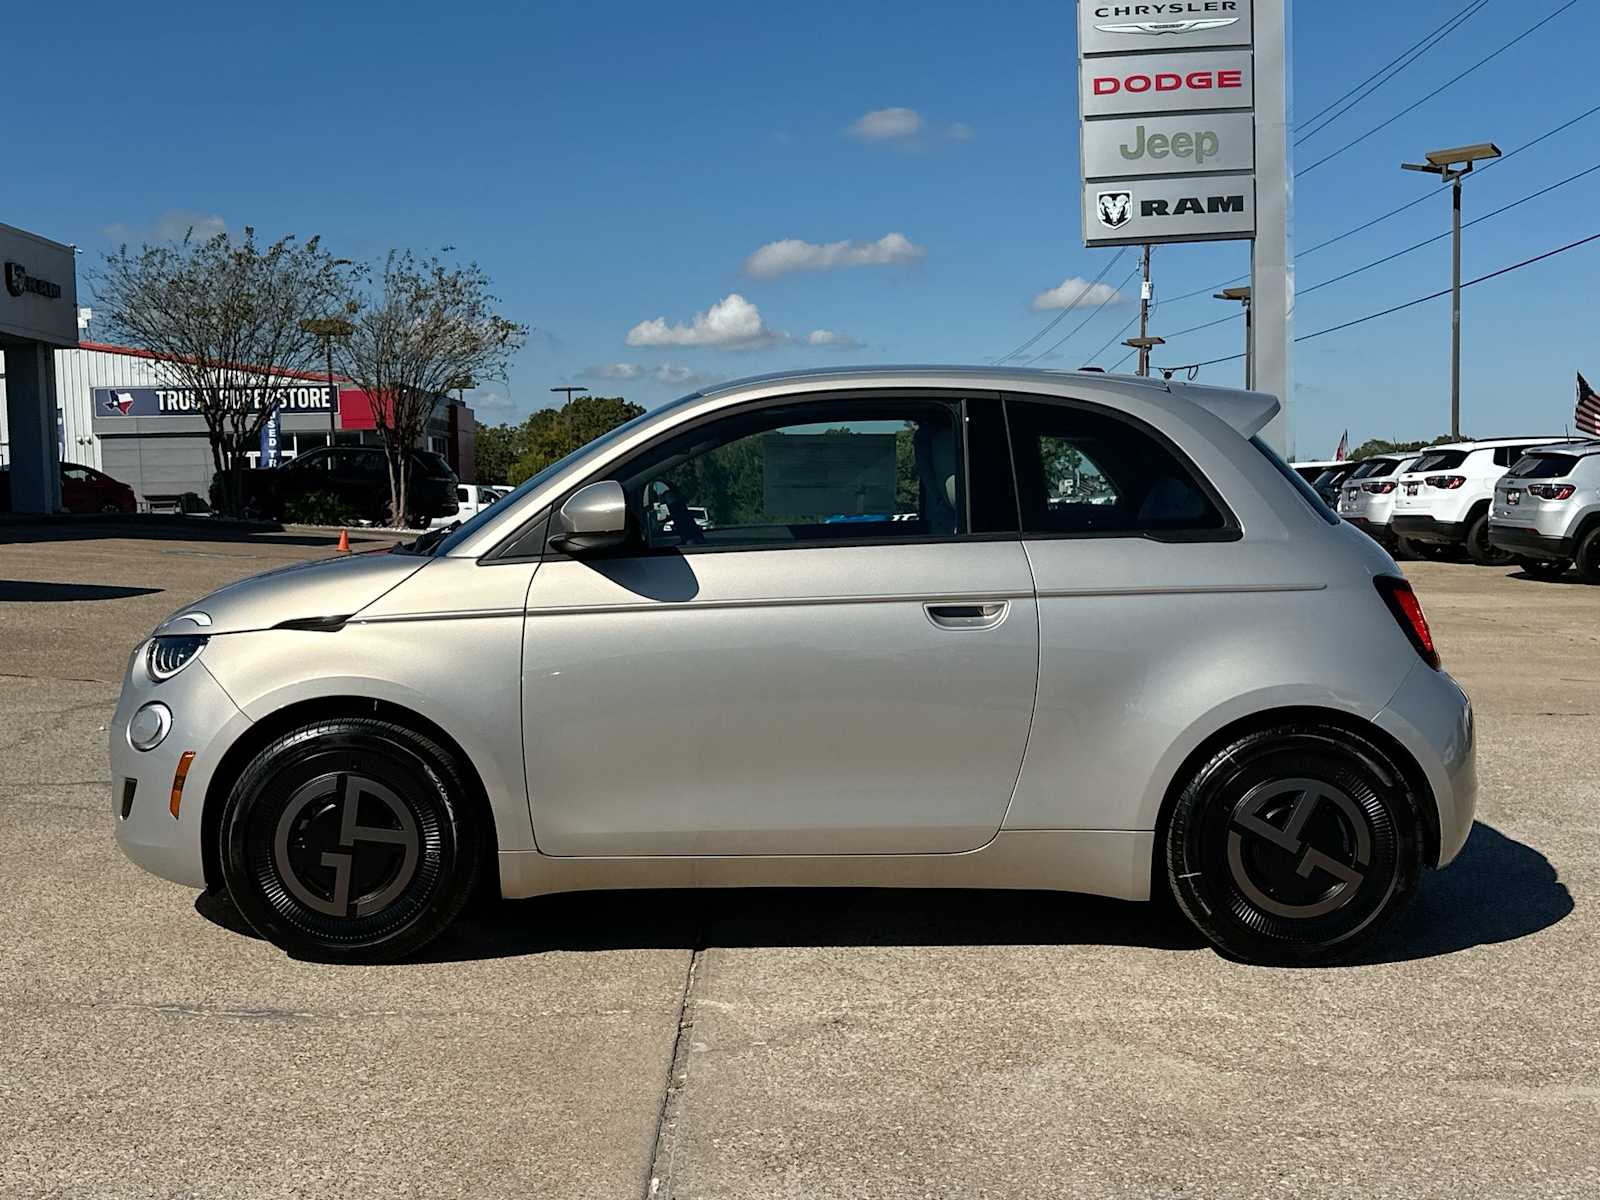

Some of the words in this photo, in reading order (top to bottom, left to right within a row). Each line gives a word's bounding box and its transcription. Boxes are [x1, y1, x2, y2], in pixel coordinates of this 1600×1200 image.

[1095, 1, 1237, 18] CHRYSLER
[1093, 70, 1242, 95] DODGE
[1119, 126, 1219, 164] Jeep
[1141, 195, 1244, 216] RAM
